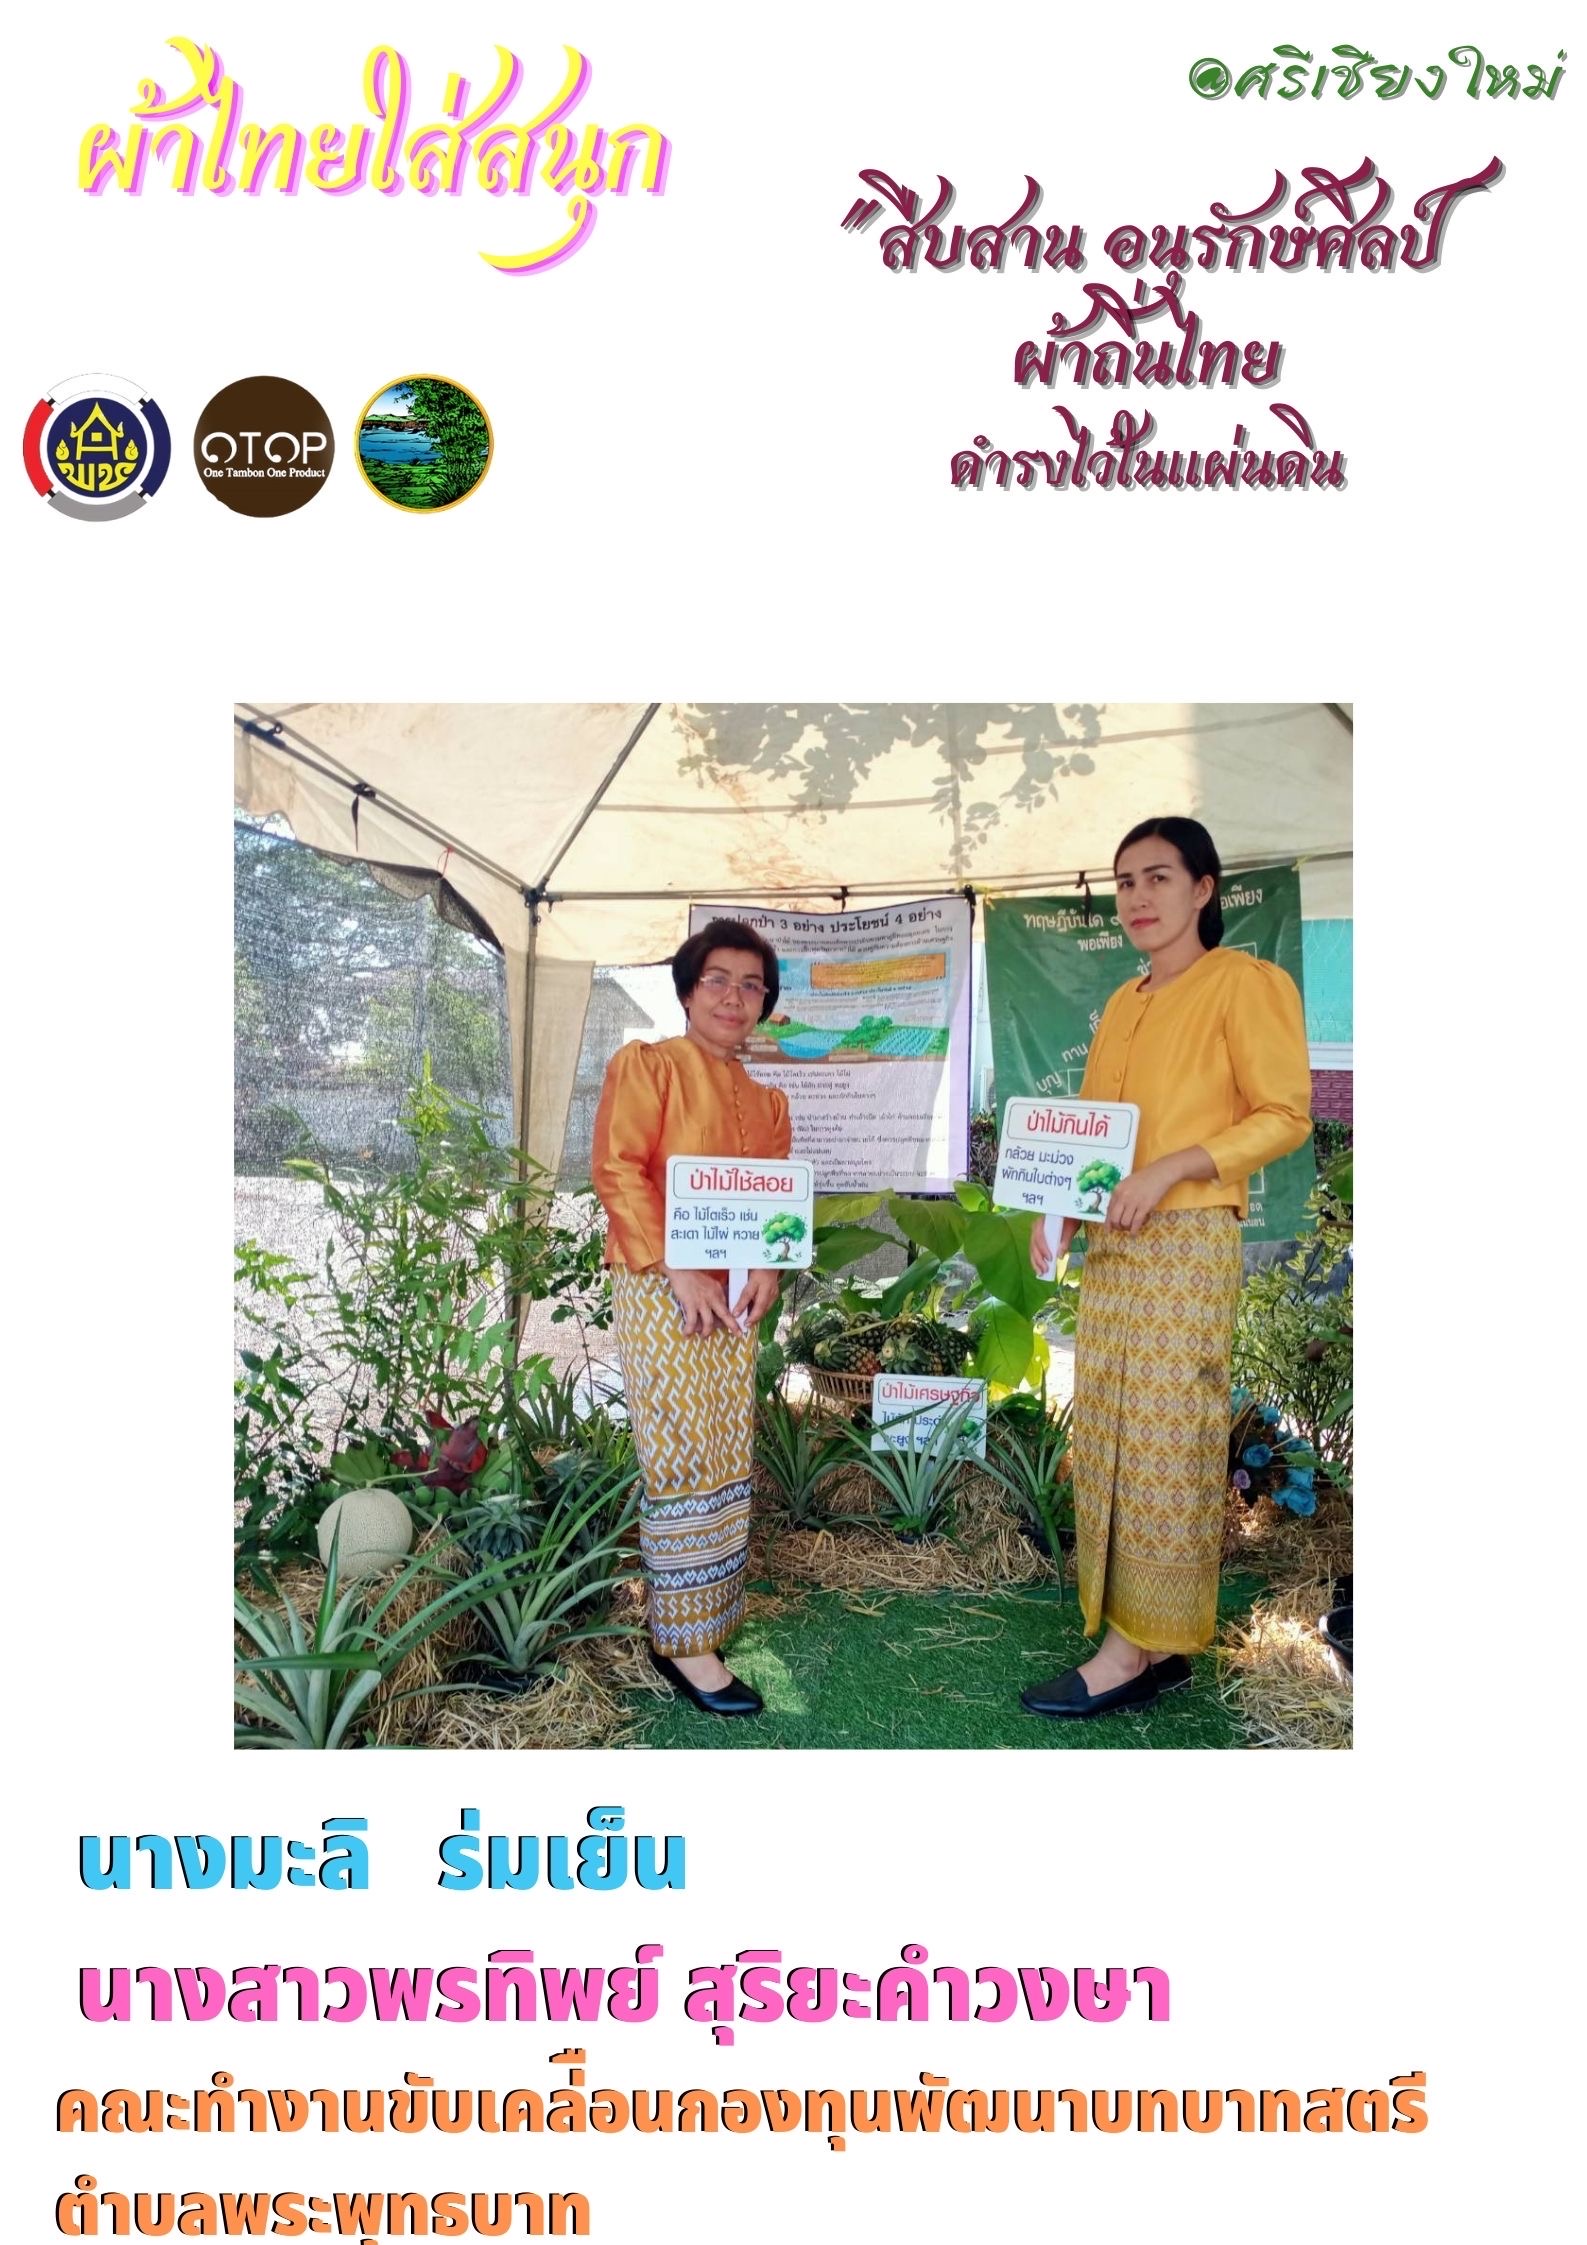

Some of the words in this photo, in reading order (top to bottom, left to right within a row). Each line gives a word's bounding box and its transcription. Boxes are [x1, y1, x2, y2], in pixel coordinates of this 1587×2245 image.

[1220, 884, 1263, 910] อเพียง
[780, 918, 788, 930] 3
[794, 919, 824, 933] อย่าง
[831, 913, 889, 933] ประโยชน์
[894, 914, 902, 925] 4
[909, 907, 942, 923] อย่าง
[1077, 931, 1123, 952] พอเพียง
[1061, 1043, 1088, 1062] ทาน
[1036, 1071, 1063, 1095] บุญ
[1027, 1109, 1111, 1138] ป่าไม้กินได้
[1004, 1146, 1034, 1162] กล้วย
[1039, 1150, 1074, 1166] มะม่วง
[690, 1167, 793, 1192] ป่าไม้ใช้สอย
[1022, 1192, 1044, 1206] ฯลฯ
[673, 1207, 690, 1221] คือ
[694, 1206, 736, 1222] ไม้โตเร็ว
[740, 1208, 758, 1222] เช่น
[703, 1225, 729, 1241] ไม้ไผ่
[733, 1230, 759, 1241] หวาย
[705, 1249, 727, 1260] ฯลฯ
